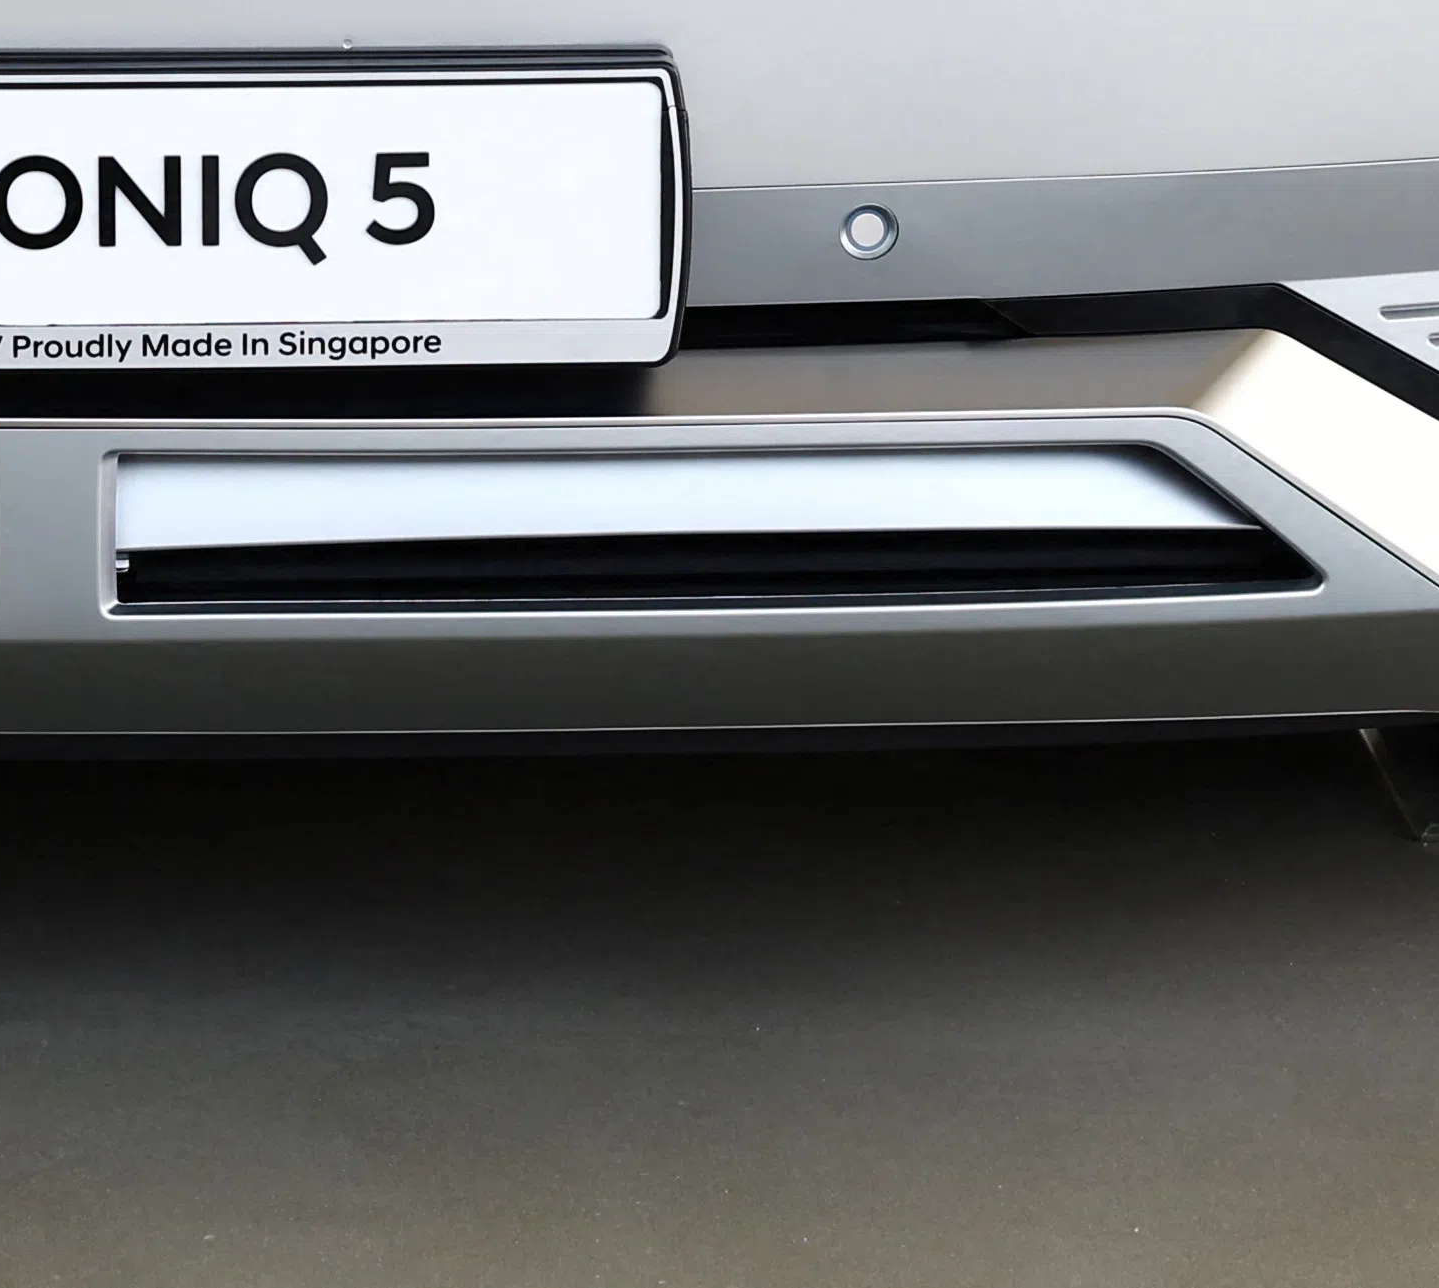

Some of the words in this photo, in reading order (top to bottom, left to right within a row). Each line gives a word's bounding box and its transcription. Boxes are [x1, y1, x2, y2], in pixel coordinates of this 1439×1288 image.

[366, 152, 434, 245] 5
[13, 334, 132, 362] Proudly
[143, 333, 232, 356] Made
[243, 333, 268, 355] In
[279, 331, 441, 360] Singapore
